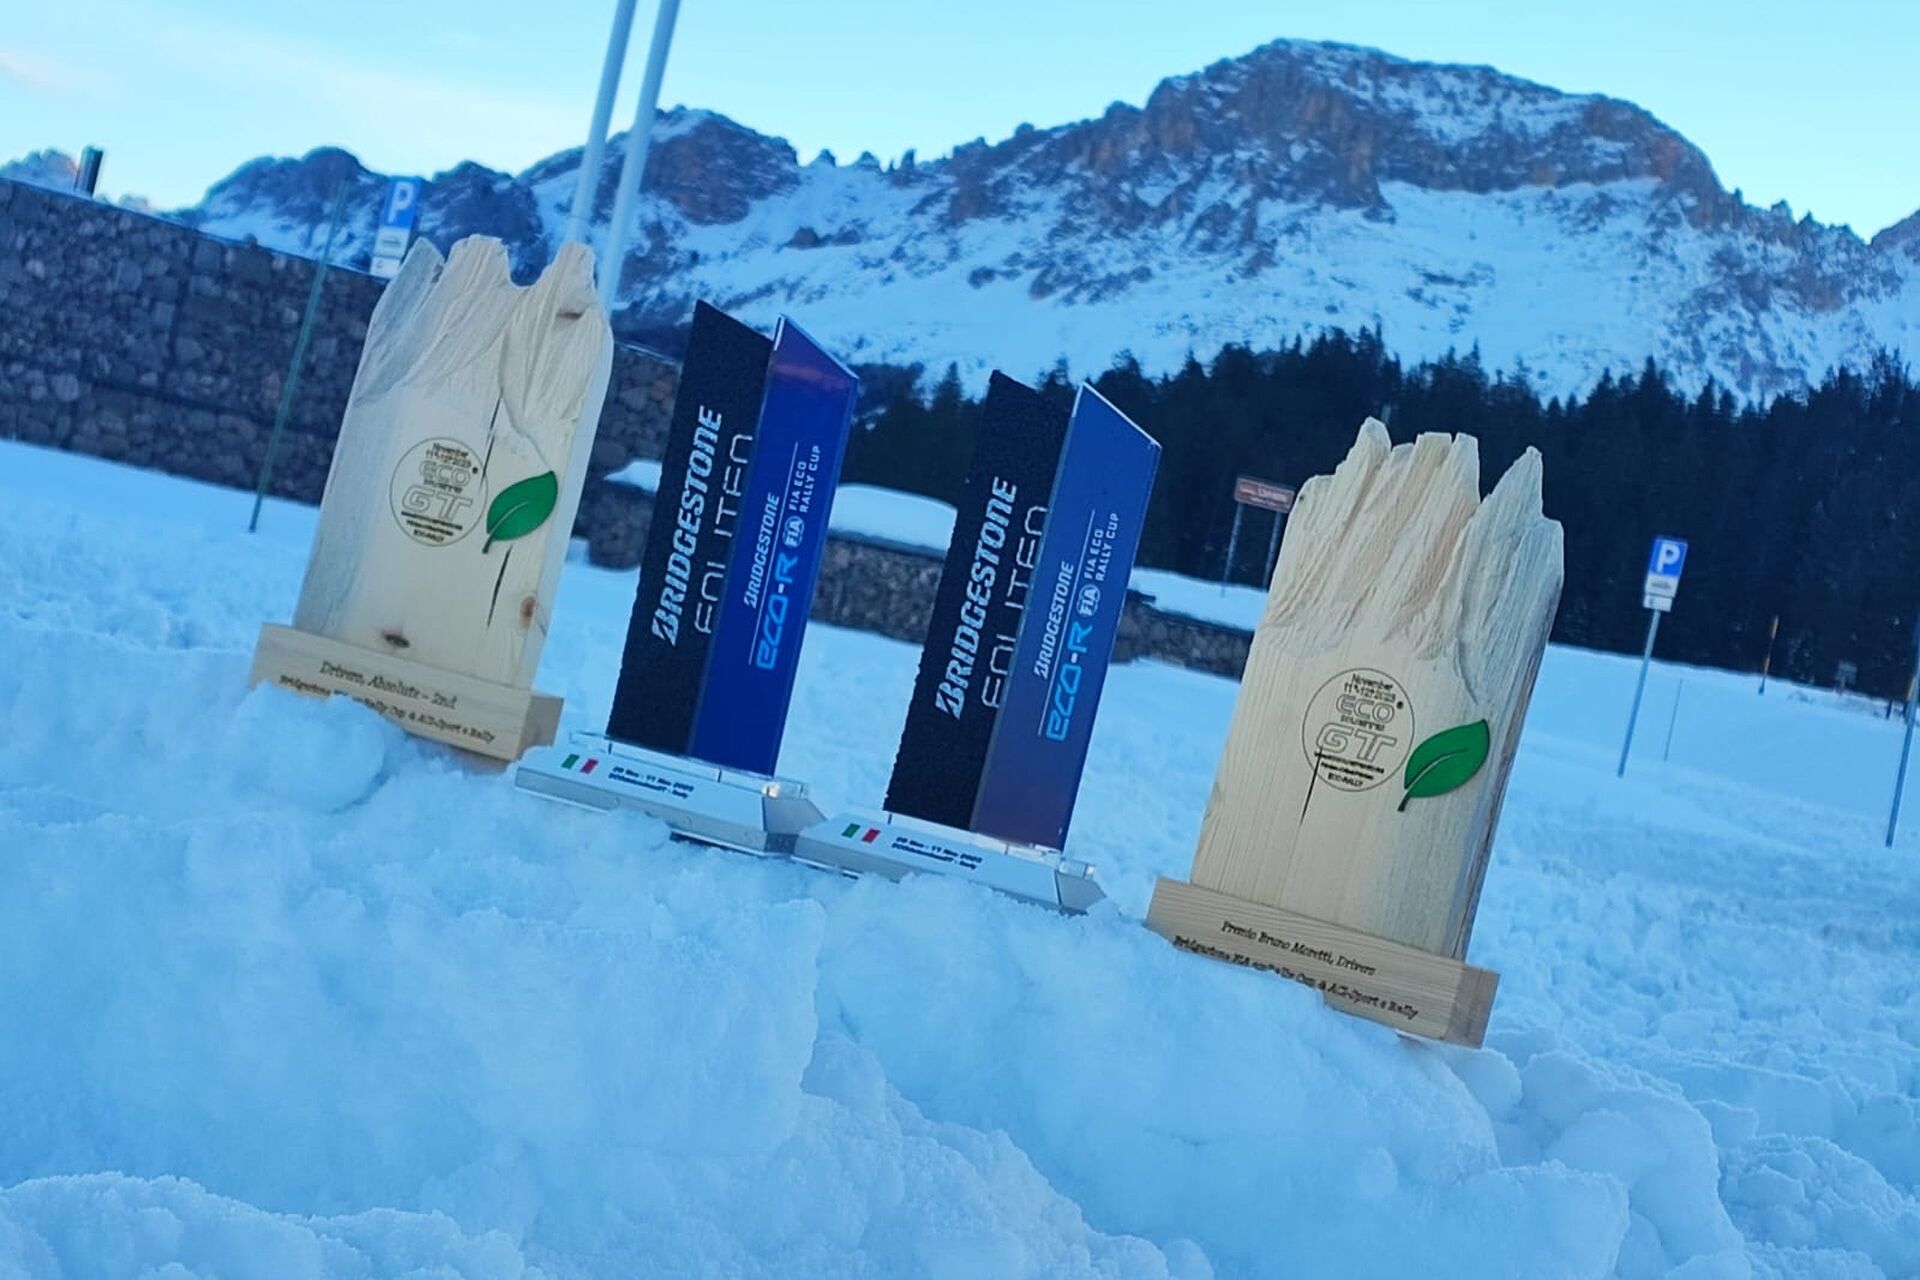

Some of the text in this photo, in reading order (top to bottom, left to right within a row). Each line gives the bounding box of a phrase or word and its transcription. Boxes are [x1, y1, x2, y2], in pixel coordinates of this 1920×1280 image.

[387, 180, 414, 223] P
[419, 460, 472, 488] ECO
[788, 461, 807, 511] FIA ECO
[799, 445, 820, 513] RALLY CUP
[402, 484, 473, 522] GT
[651, 404, 722, 647] BRIDGESTONE
[743, 491, 780, 609] BRIDGESTONE
[785, 519, 804, 547] FIA
[1084, 528, 1104, 579] FIA ECO
[1095, 513, 1119, 581] RALLY CUP
[1656, 541, 1681, 574] P
[934, 476, 1017, 721] BRIDGESTONE
[1033, 561, 1075, 679] BRIDGESTONE
[1078, 588, 1098, 616] FIA
[1336, 694, 1395, 724] ECO
[1316, 722, 1398, 763] GT
[1221, 920, 1257, 940] Premio
[1258, 931, 1291, 950] Bruno
[1290, 941, 1335, 965] Moretti,
